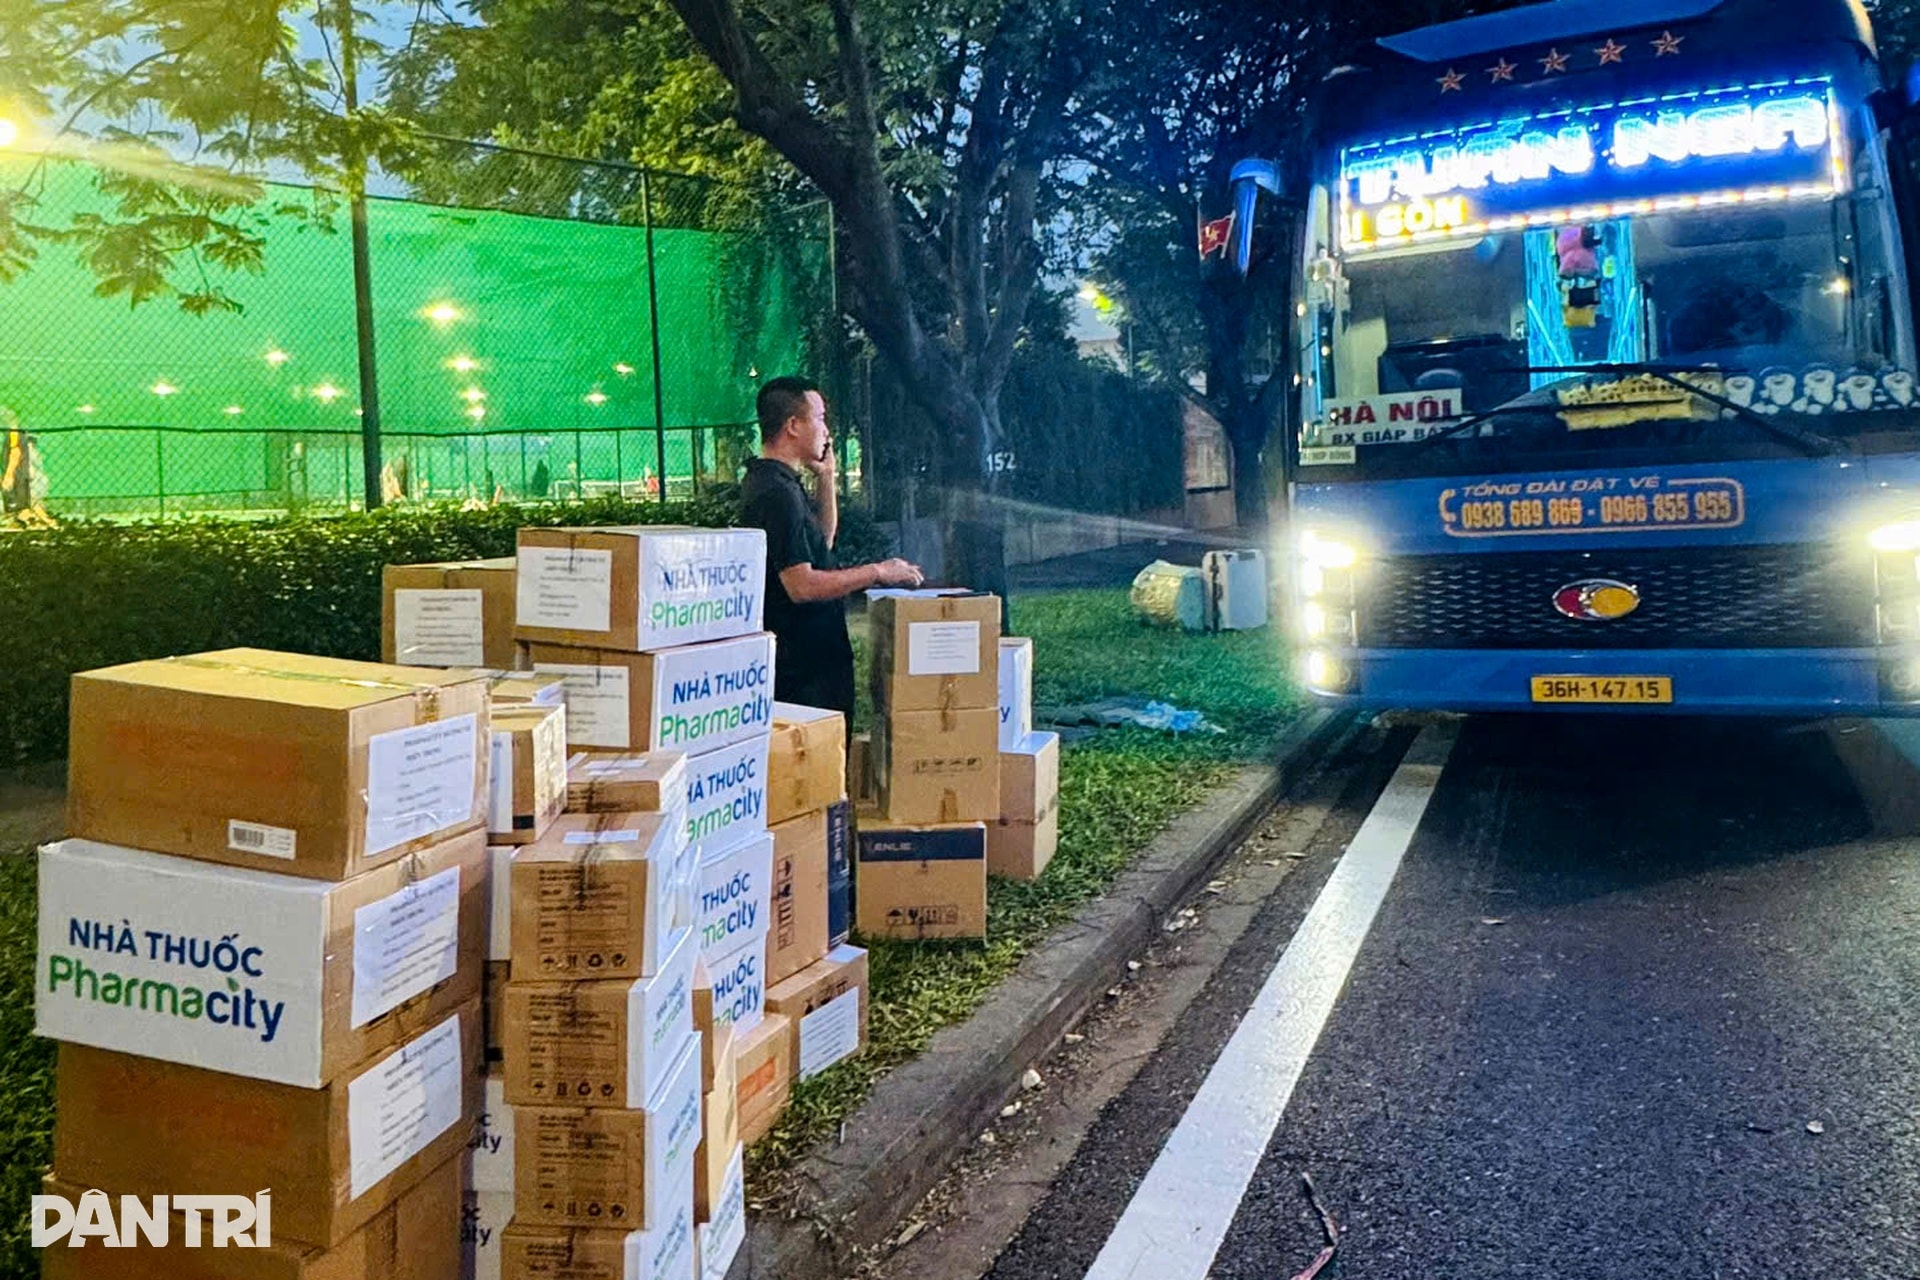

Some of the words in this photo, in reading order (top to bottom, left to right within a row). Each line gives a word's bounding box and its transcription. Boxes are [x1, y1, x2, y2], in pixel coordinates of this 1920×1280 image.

[1330, 401, 1376, 425] HÀ
[1389, 396, 1453, 424] NỘI
[1332, 433, 1355, 445] BX
[1363, 428, 1406, 443] GIÁP
[986, 451, 1017, 471] 152
[1462, 480, 1522, 497] TỔNG
[1526, 480, 1566, 494] ĐÀI
[1630, 476, 1661, 489] VÉ
[1461, 502, 1505, 528] 0938
[1653, 493, 1689, 522] 855
[1694, 490, 1732, 520] 955
[663, 562, 698, 591] NHÀ
[700, 560, 747, 586] THUỐC
[651, 587, 754, 631] Pharmacity
[672, 671, 711, 704] NHÀ
[715, 659, 766, 695] THUỐC
[1541, 681, 1660, 699] 36H-147.15
[660, 690, 773, 747] Pharmacity
[707, 754, 756, 796] THUỐC
[687, 785, 762, 842] armacity
[702, 869, 751, 914] THUỐC
[69, 917, 139, 957] NHÀ
[143, 932, 264, 978] THUỐC
[49, 954, 285, 1042] Pharmacity
[714, 953, 756, 1002] HUỐC
